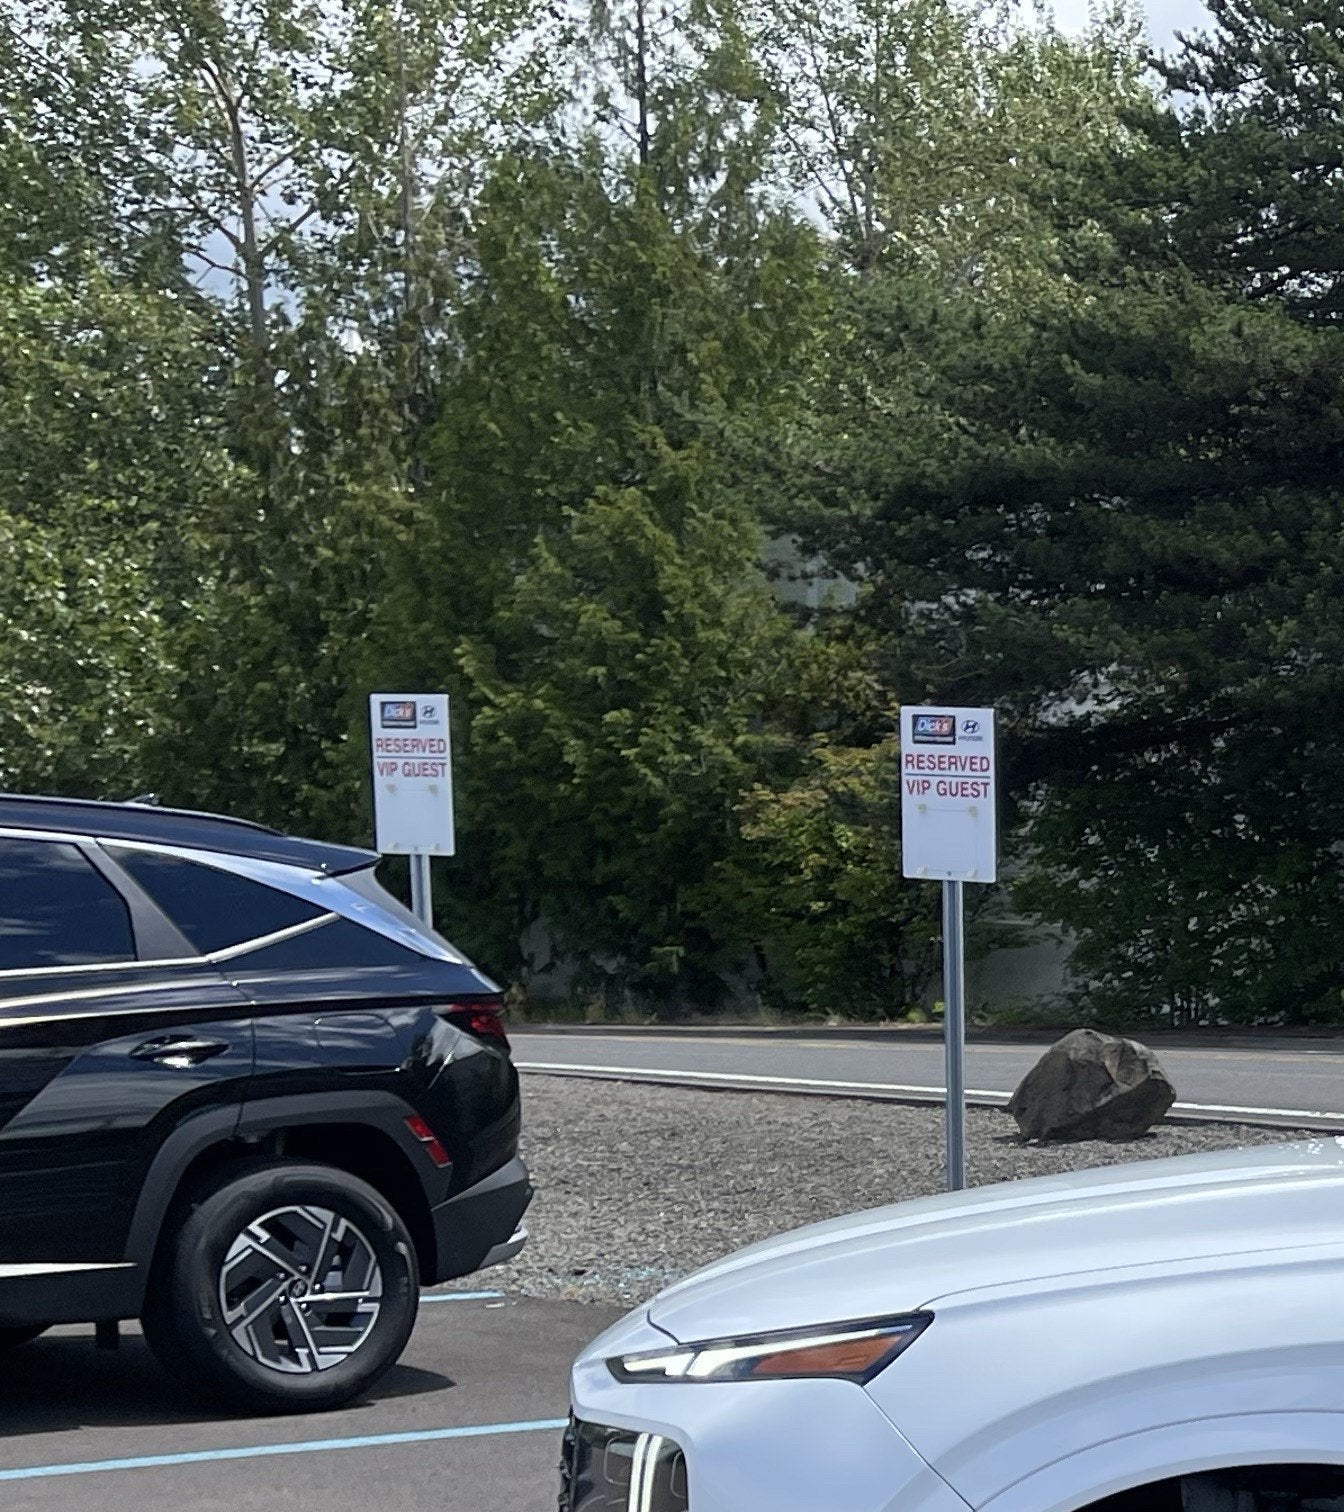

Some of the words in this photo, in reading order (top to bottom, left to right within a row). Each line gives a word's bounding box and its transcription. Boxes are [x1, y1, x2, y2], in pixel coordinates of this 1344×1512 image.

[375, 737, 447, 754] RESERVED
[376, 762, 398, 777] VIP
[401, 762, 447, 777] GUEST
[905, 753, 990, 773] RESERVED
[906, 780, 931, 796] VIP
[936, 780, 990, 799] GUEST
